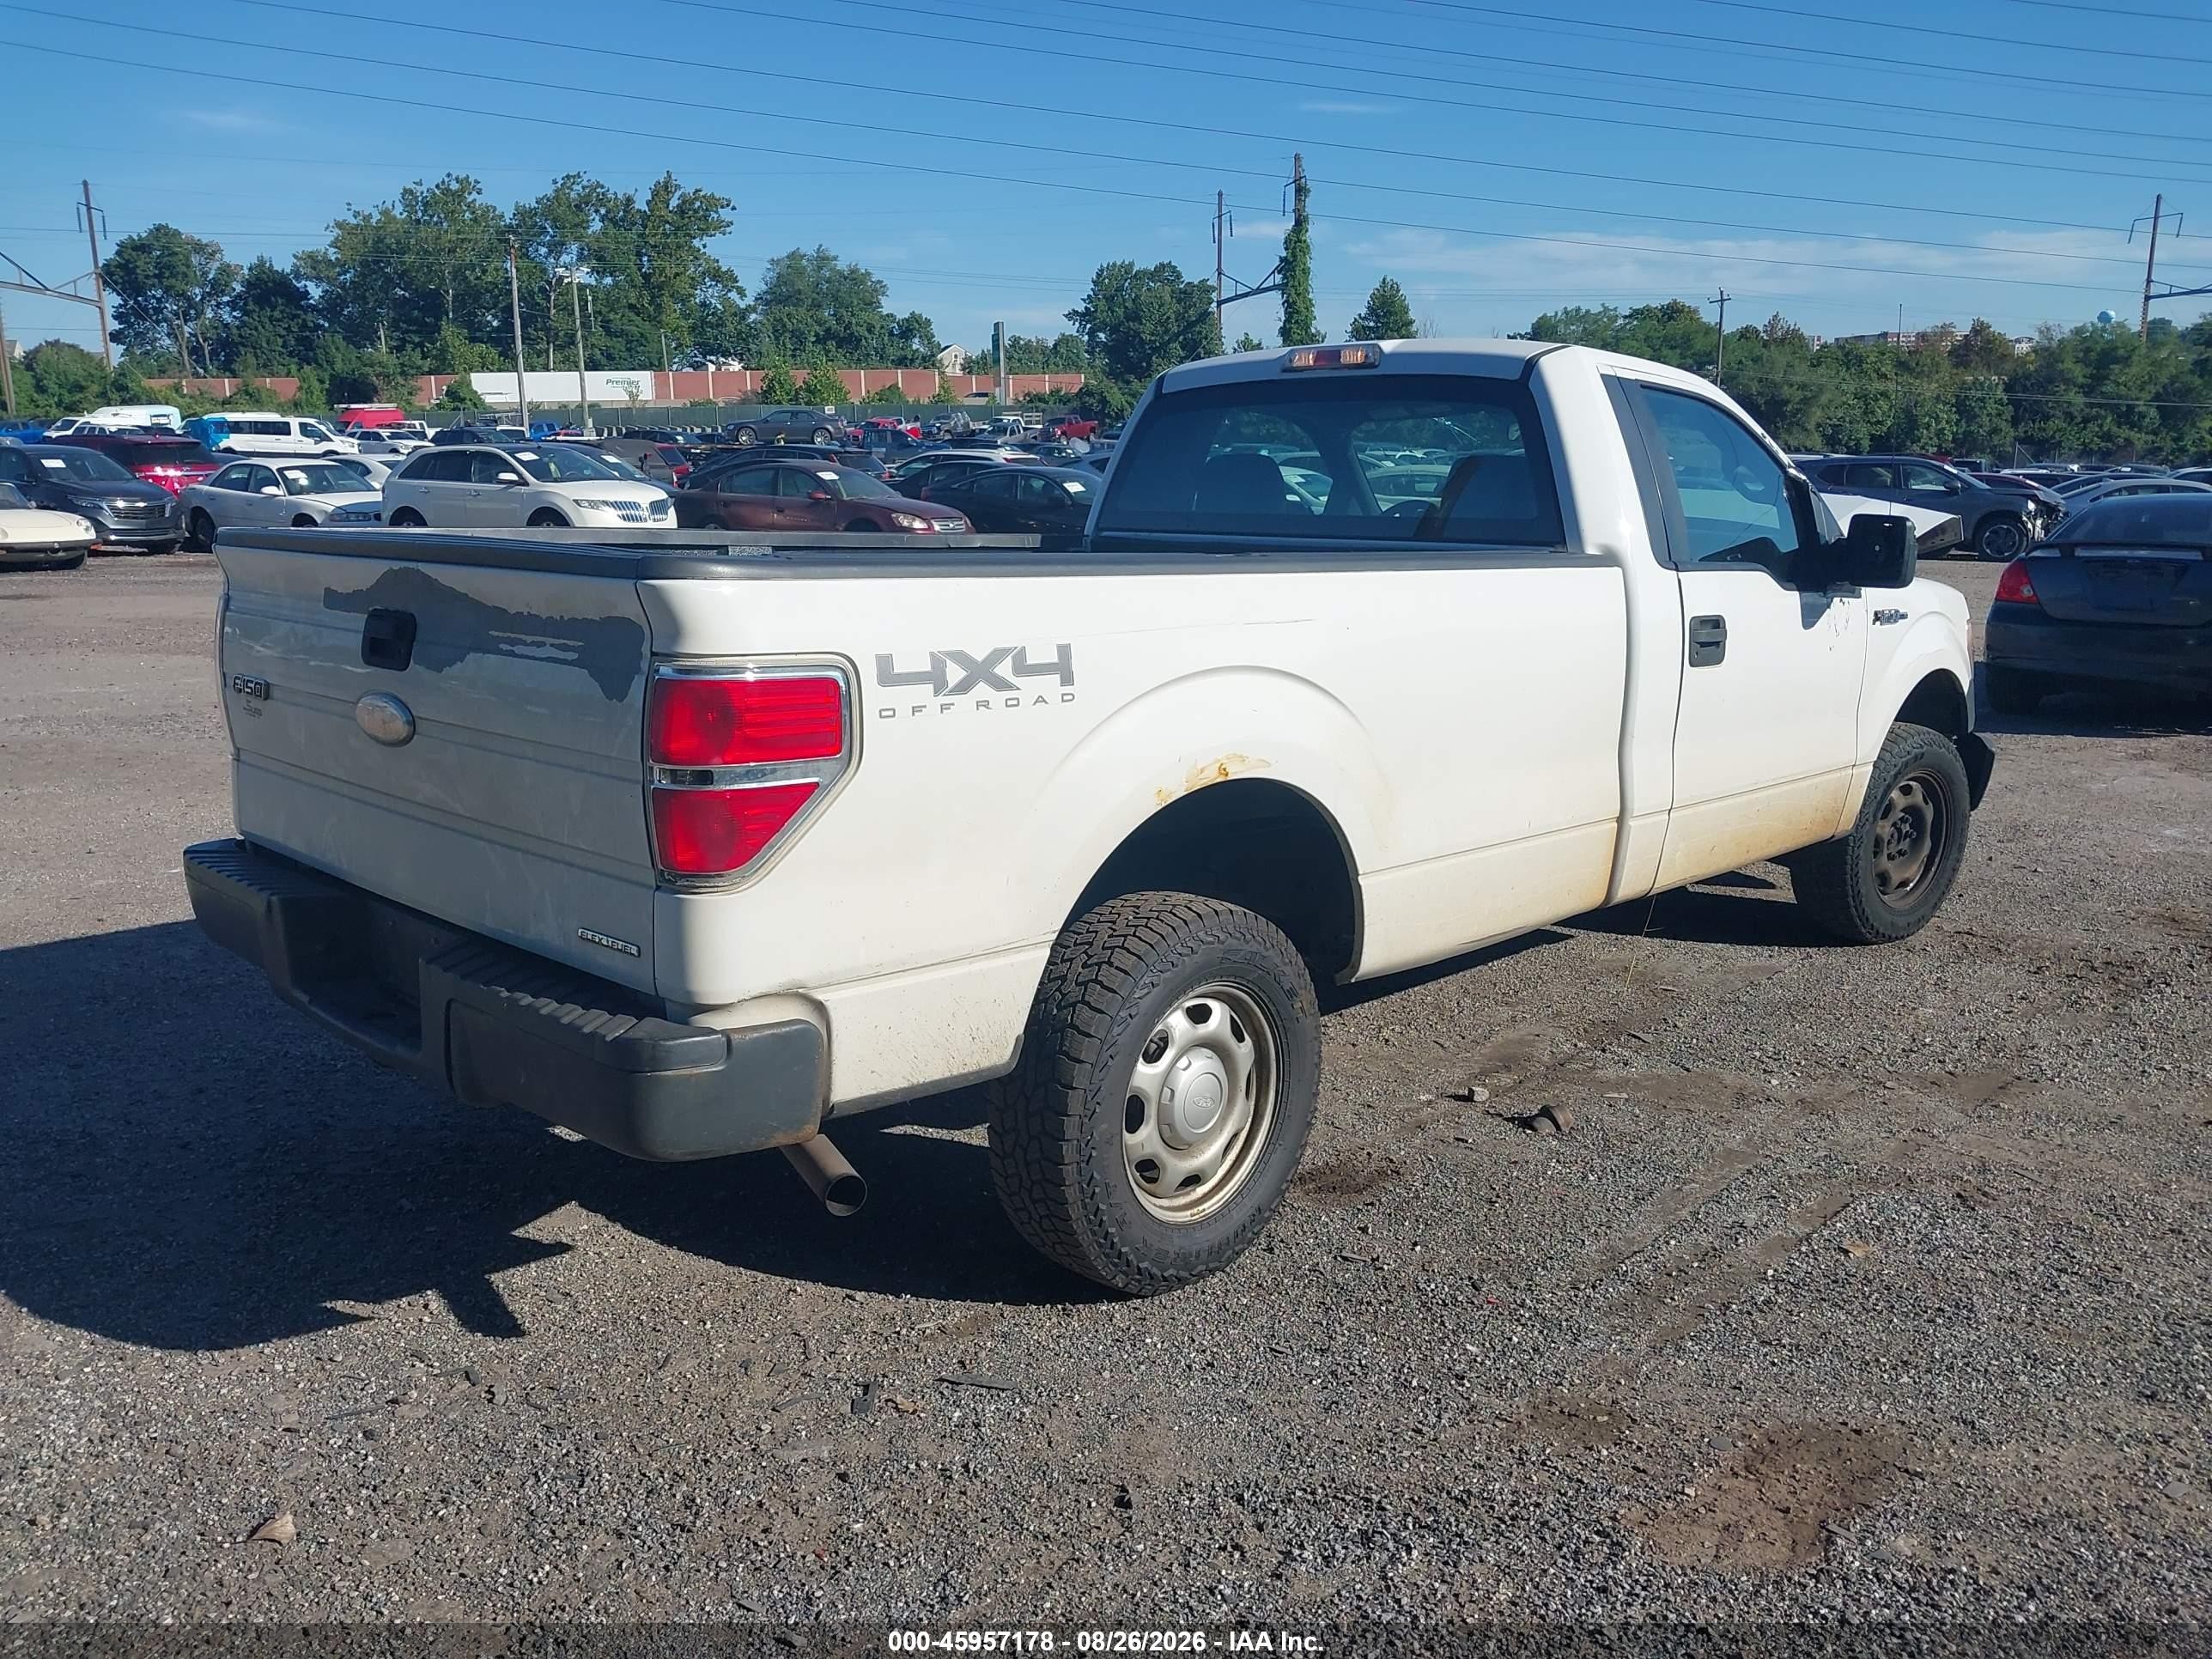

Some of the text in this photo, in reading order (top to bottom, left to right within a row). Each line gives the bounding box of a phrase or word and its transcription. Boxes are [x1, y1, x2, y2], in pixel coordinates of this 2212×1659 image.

[875, 643, 1075, 697] 4X4
[878, 692, 1076, 720] OFF ROAD
